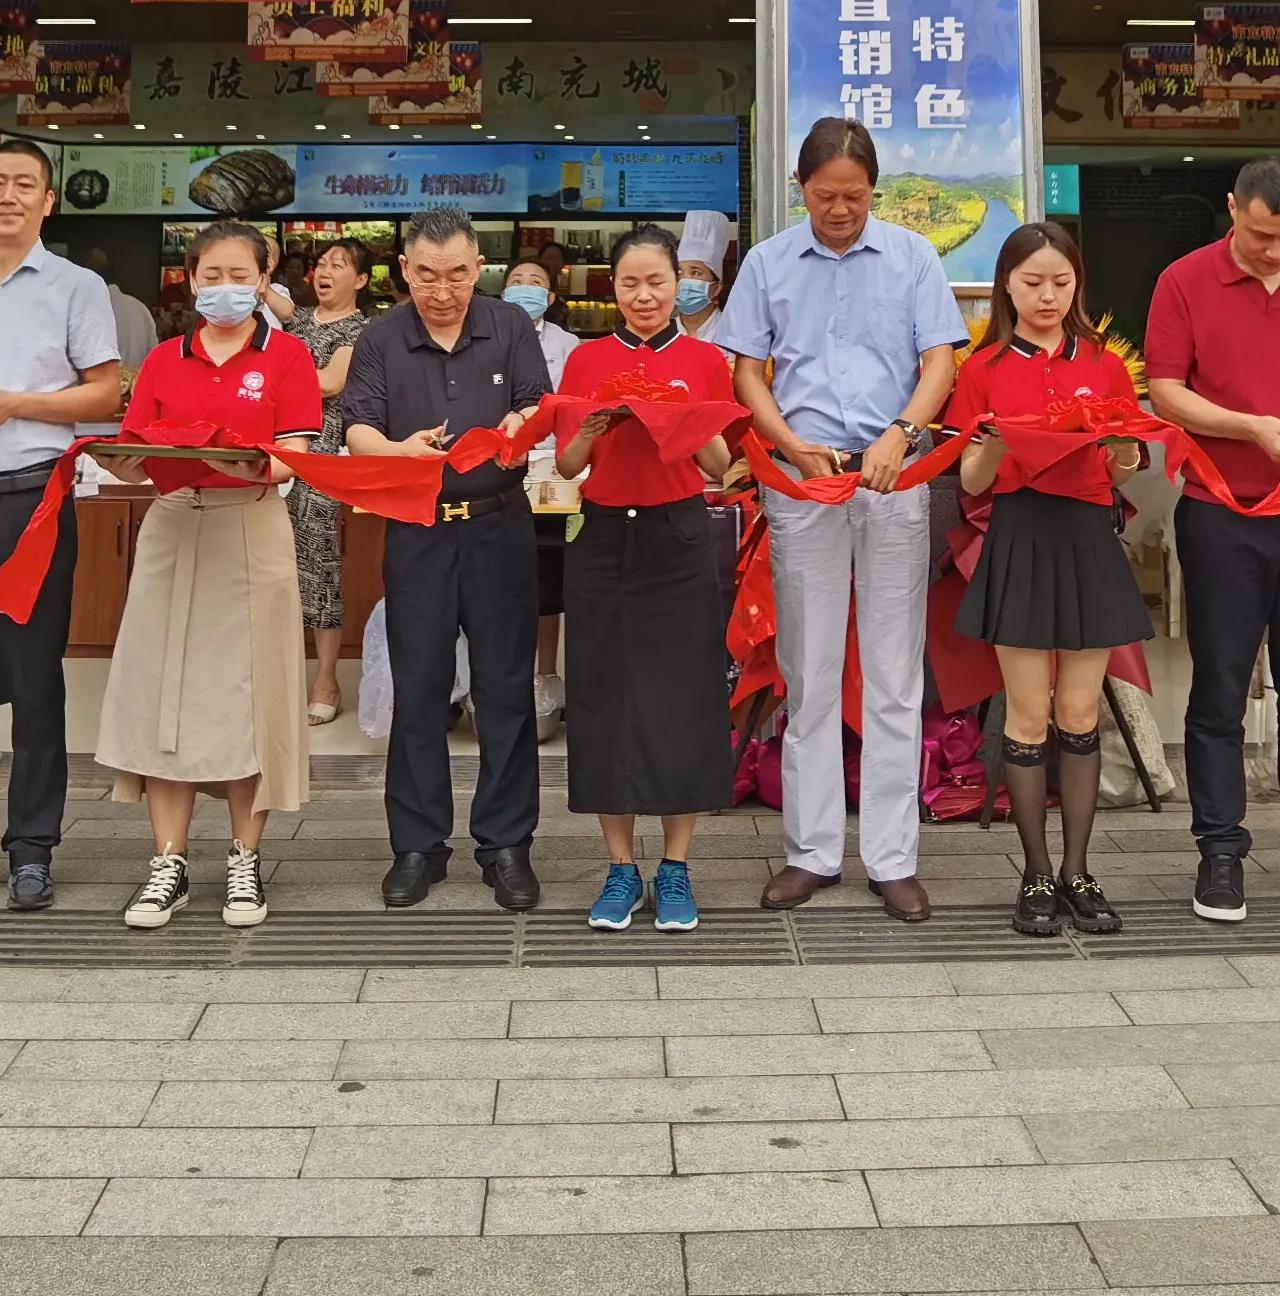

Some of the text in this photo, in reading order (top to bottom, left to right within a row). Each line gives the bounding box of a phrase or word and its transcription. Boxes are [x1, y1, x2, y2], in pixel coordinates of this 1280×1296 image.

[145, 54, 671, 102] 嘉陵江 南充城
